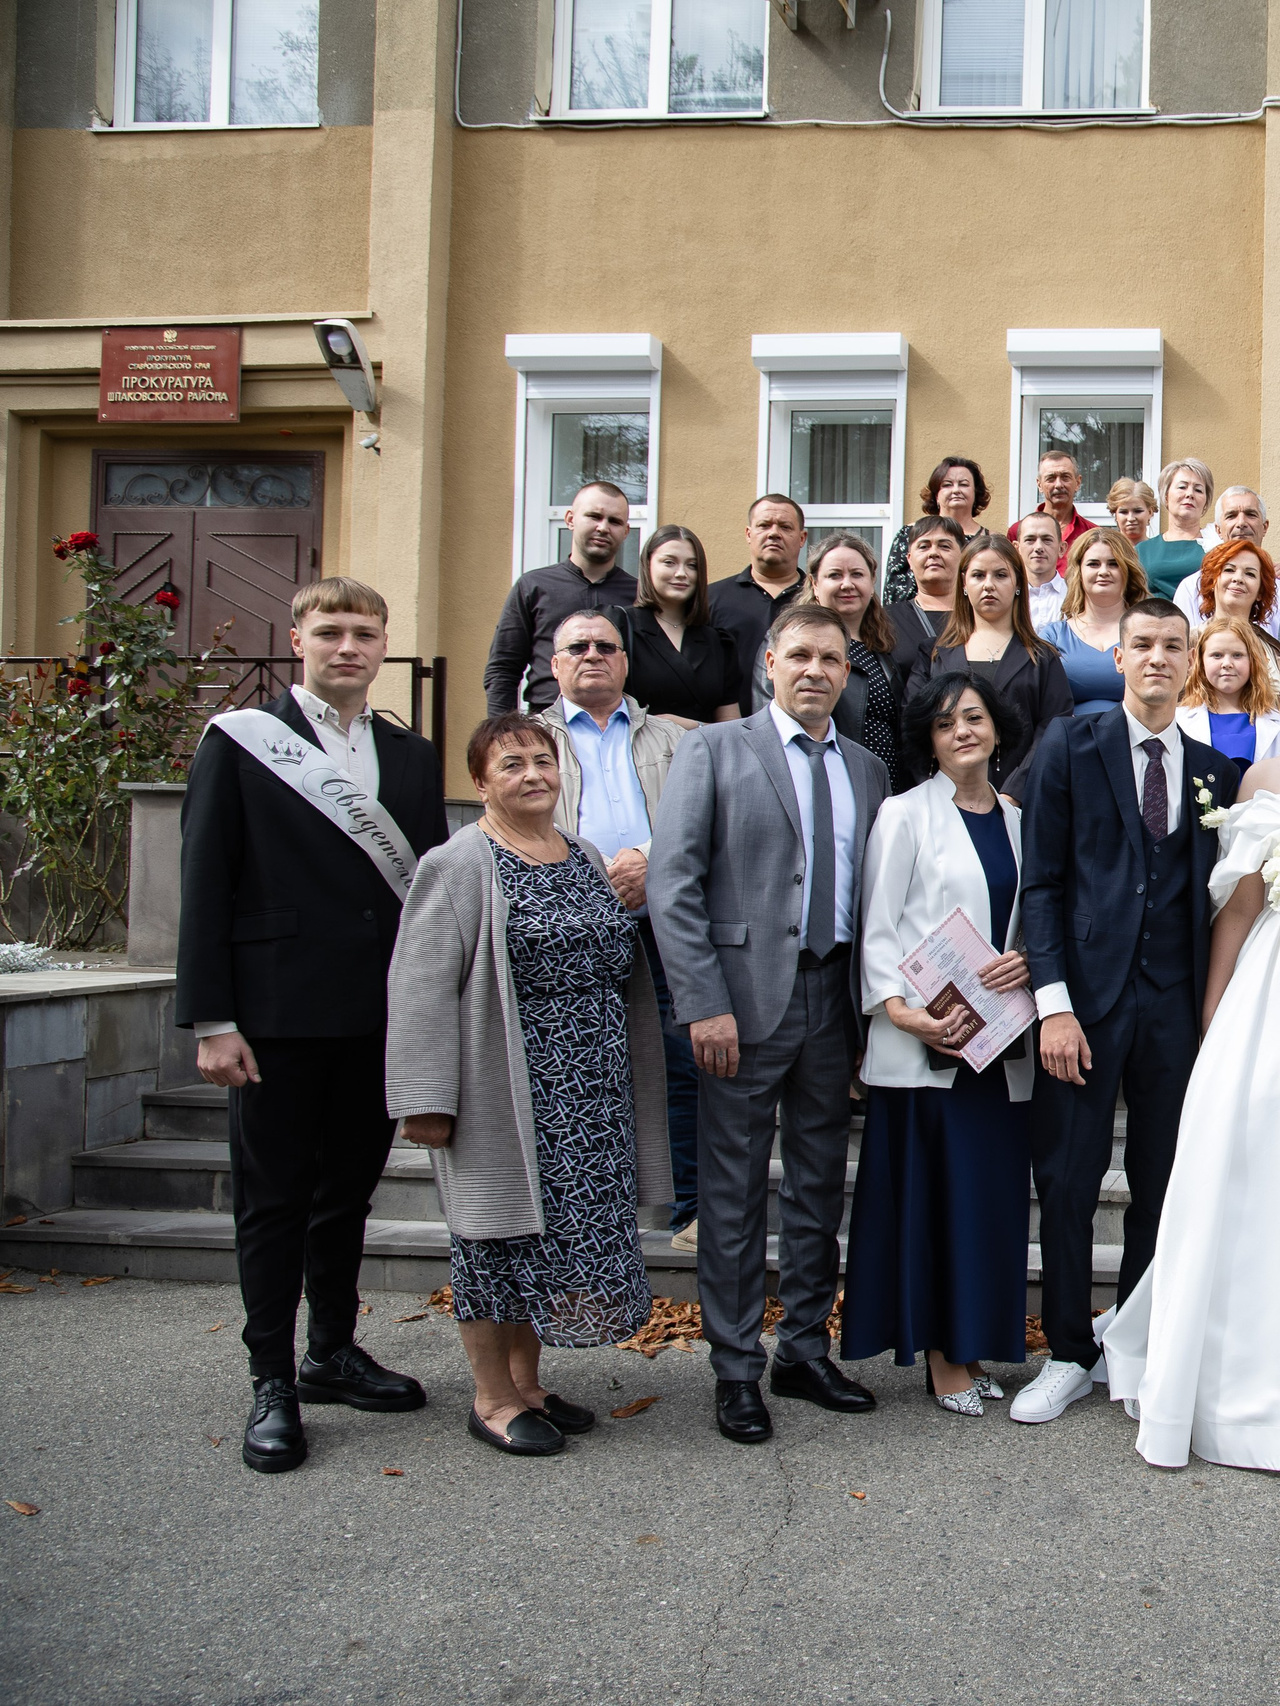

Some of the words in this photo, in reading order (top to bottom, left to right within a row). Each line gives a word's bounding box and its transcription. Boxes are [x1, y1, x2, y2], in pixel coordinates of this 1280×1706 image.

[146, 354, 192, 362] ПРОКУРАТУРА
[122, 376, 214, 389] ПРОКУРАТУРА
[107, 391, 184, 402] ШПАКОВСКОГО
[187, 390, 229, 403] РАЙОНА
